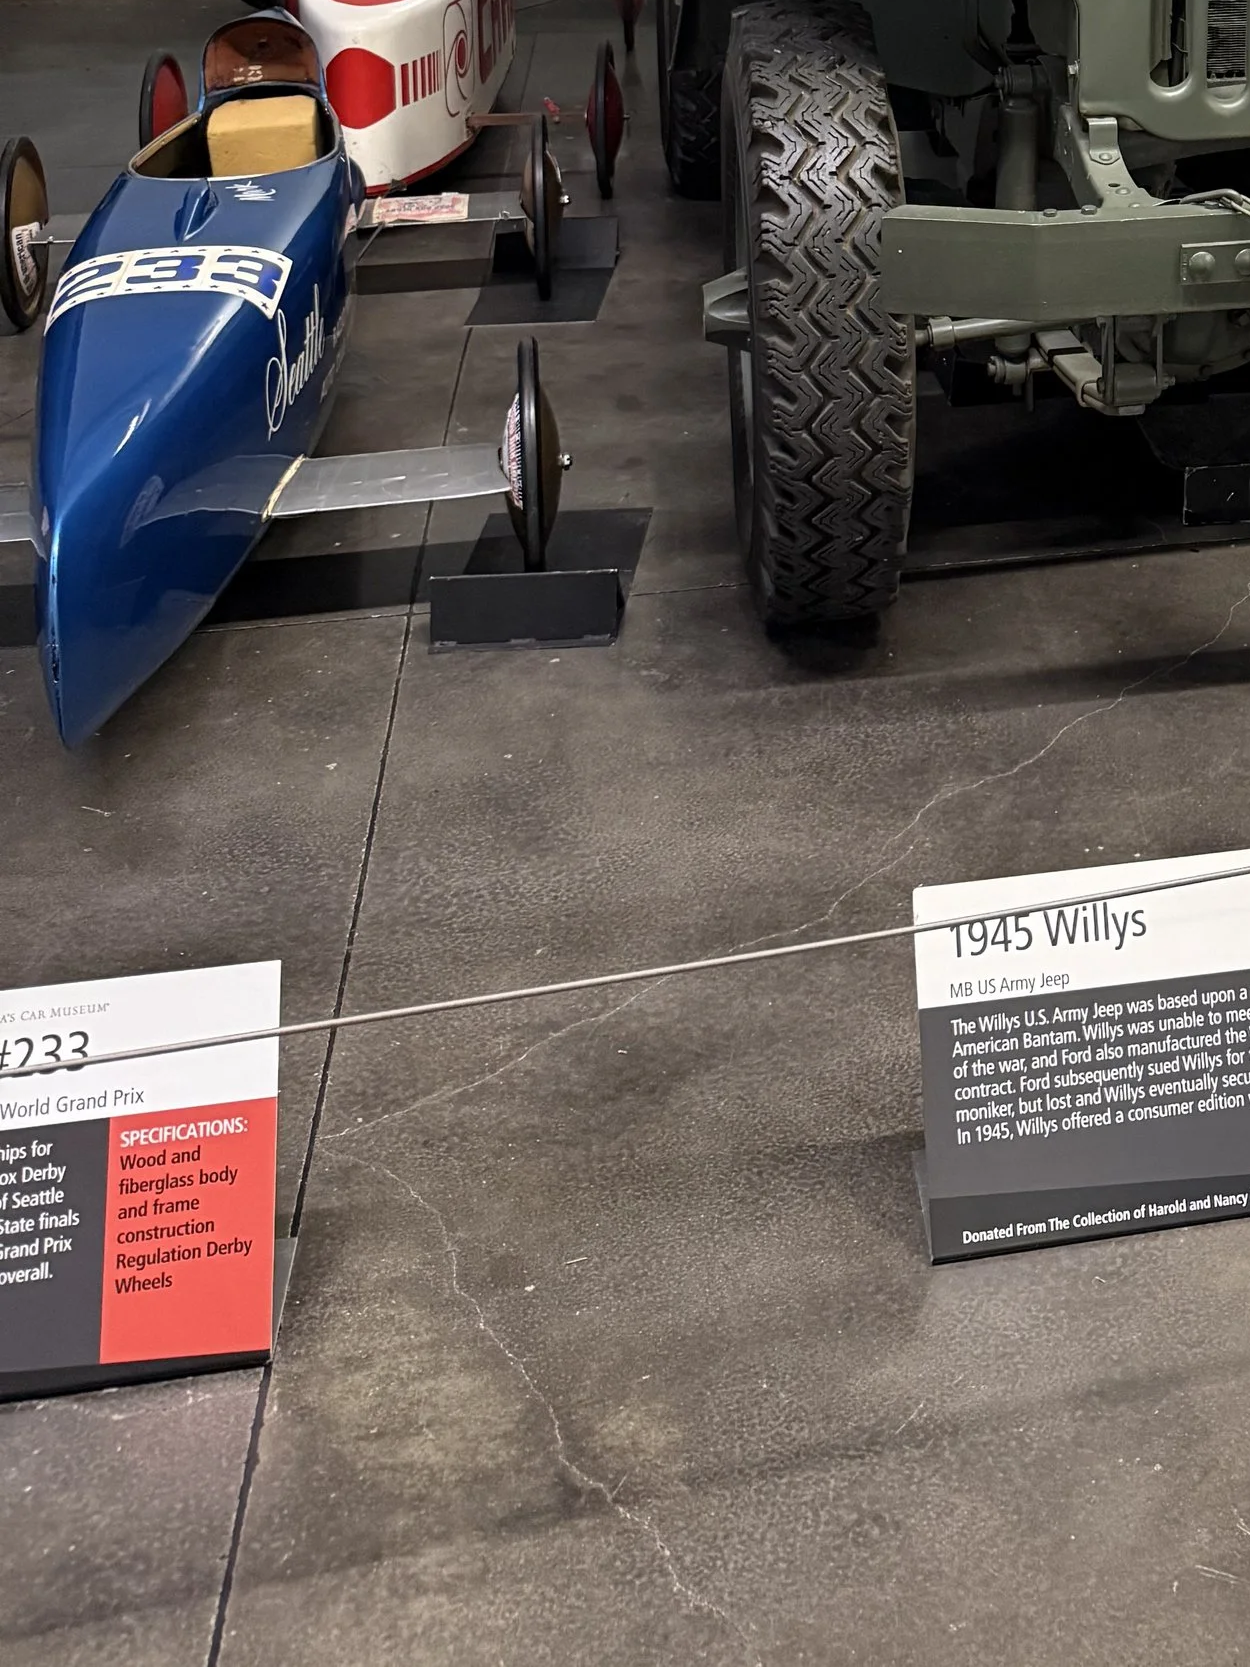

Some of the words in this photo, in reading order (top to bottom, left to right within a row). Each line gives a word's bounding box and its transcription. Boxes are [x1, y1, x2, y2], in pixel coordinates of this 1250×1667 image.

[50, 254, 284, 315] 233
[266, 283, 326, 442] Seattle
[950, 912, 1033, 958] 1945
[1043, 901, 1147, 951] Willys
[950, 981, 973, 998] MB
[978, 978, 996, 995] US
[1000, 977, 1035, 993] Army
[1040, 973, 1070, 989] Jeep
[20, 1010, 46, 1021] CAR
[950, 1018, 976, 1036] The
[978, 1012, 1020, 1033] Willys
[1024, 1009, 1050, 1027] U.S.
[1052, 1007, 1089, 1024] Army
[1093, 1002, 1123, 1020] Jeep
[1126, 999, 1154, 1014] was
[1157, 989, 1198, 1010] based
[1202, 989, 1235, 1008] upon
[1239, 988, 1247, 1000] a
[0, 1097, 50, 1120] World
[56, 1090, 107, 1113] Grand
[114, 1087, 144, 1106] Prix
[120, 1117, 248, 1147] SPECIFICATIONS:
[31, 1140, 53, 1157] for
[120, 1149, 166, 1170] Wood
[171, 1145, 201, 1164] and
[22, 1163, 66, 1183] Derby
[119, 1173, 194, 1195] fiberglass
[199, 1165, 238, 1185] body
[12, 1187, 64, 1209] Seattle
[118, 1201, 148, 1220] and
[153, 1198, 199, 1215] frame
[38, 1209, 80, 1230] finals
[963, 1223, 1013, 1244] Donated
[1016, 1222, 1046, 1236] From
[1048, 1217, 1070, 1231] The
[1072, 1209, 1131, 1228] Collection
[1133, 1204, 1146, 1219] of
[1149, 1199, 1187, 1217] Harold
[1189, 1195, 1211, 1211] and
[1213, 1193, 1248, 1207] Nancy
[117, 1219, 214, 1244] construction
[44, 1235, 72, 1254] Prix
[116, 1245, 201, 1271] Regulation
[207, 1237, 252, 1257] Derby
[0, 1261, 53, 1285] overall.
[115, 1272, 173, 1294] Wheels
